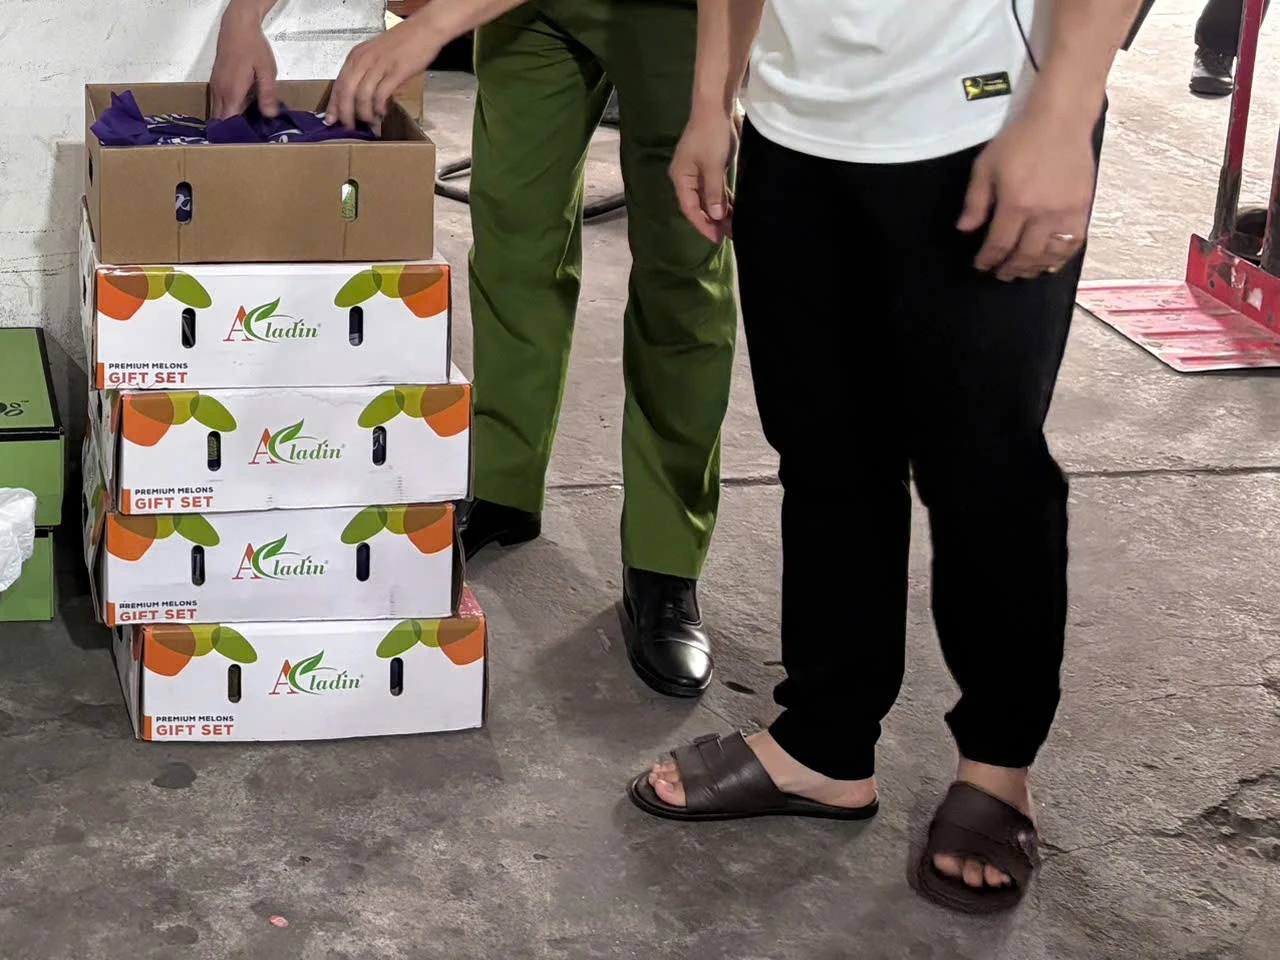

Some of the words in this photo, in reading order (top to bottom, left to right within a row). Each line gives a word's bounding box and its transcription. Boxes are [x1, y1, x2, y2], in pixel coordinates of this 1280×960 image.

[108, 372, 149, 384] GIFT
[155, 372, 188, 384] SET
[135, 497, 175, 509] GIFT
[180, 496, 214, 508] SET
[119, 601, 159, 609] PREMIUM
[120, 610, 159, 622] GIFT
[165, 608, 197, 620] SET
[156, 724, 196, 736] GIFT
[201, 724, 234, 736] SET
